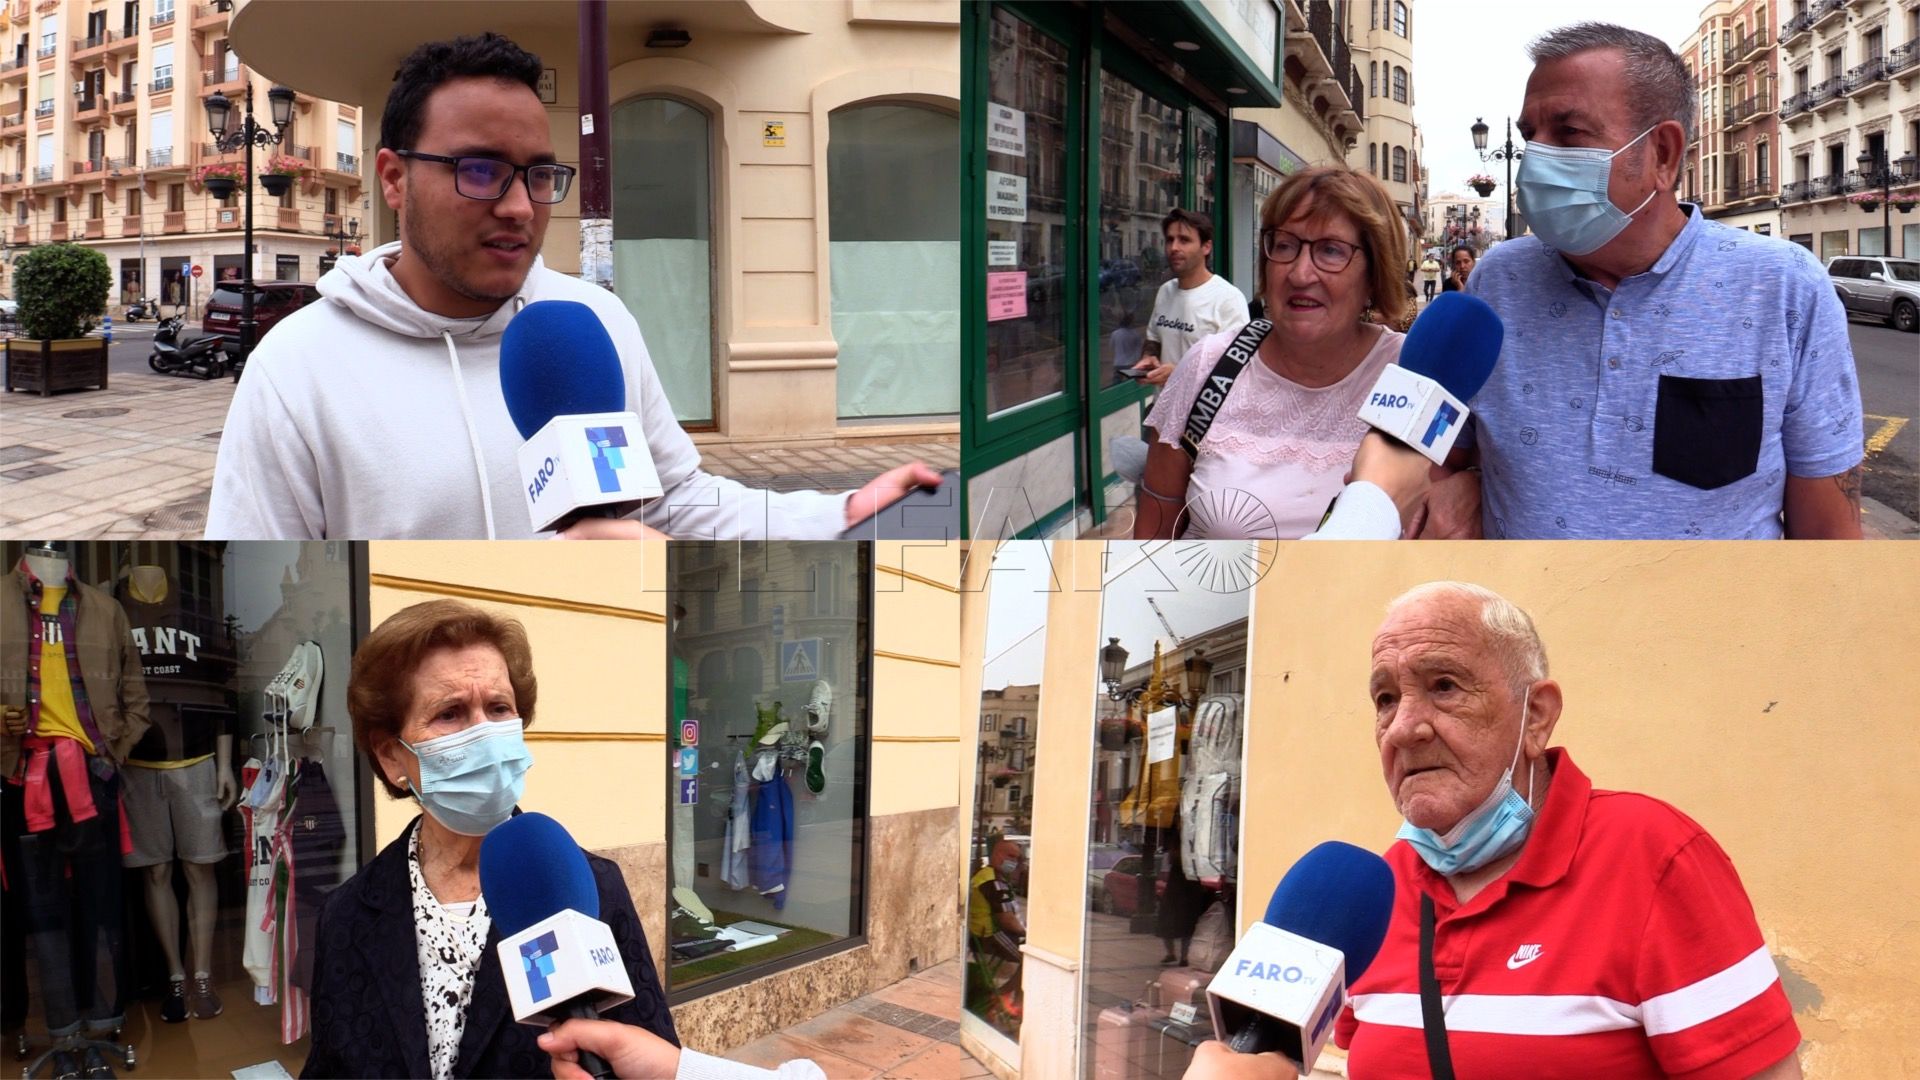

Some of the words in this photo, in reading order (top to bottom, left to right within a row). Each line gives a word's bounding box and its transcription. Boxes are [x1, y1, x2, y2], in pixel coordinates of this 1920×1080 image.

[1156, 314, 1195, 332] Dockers
[1184, 375, 1233, 445] BIMBA
[1226, 317, 1274, 366] BIMB
[1370, 393, 1408, 409] FARO
[528, 456, 554, 504] FARO
[131, 626, 201, 662] ANT
[154, 665, 181, 674] COAST
[590, 946, 615, 968] FARO
[1514, 943, 1543, 960] NIKE
[1234, 959, 1303, 983] FARO
